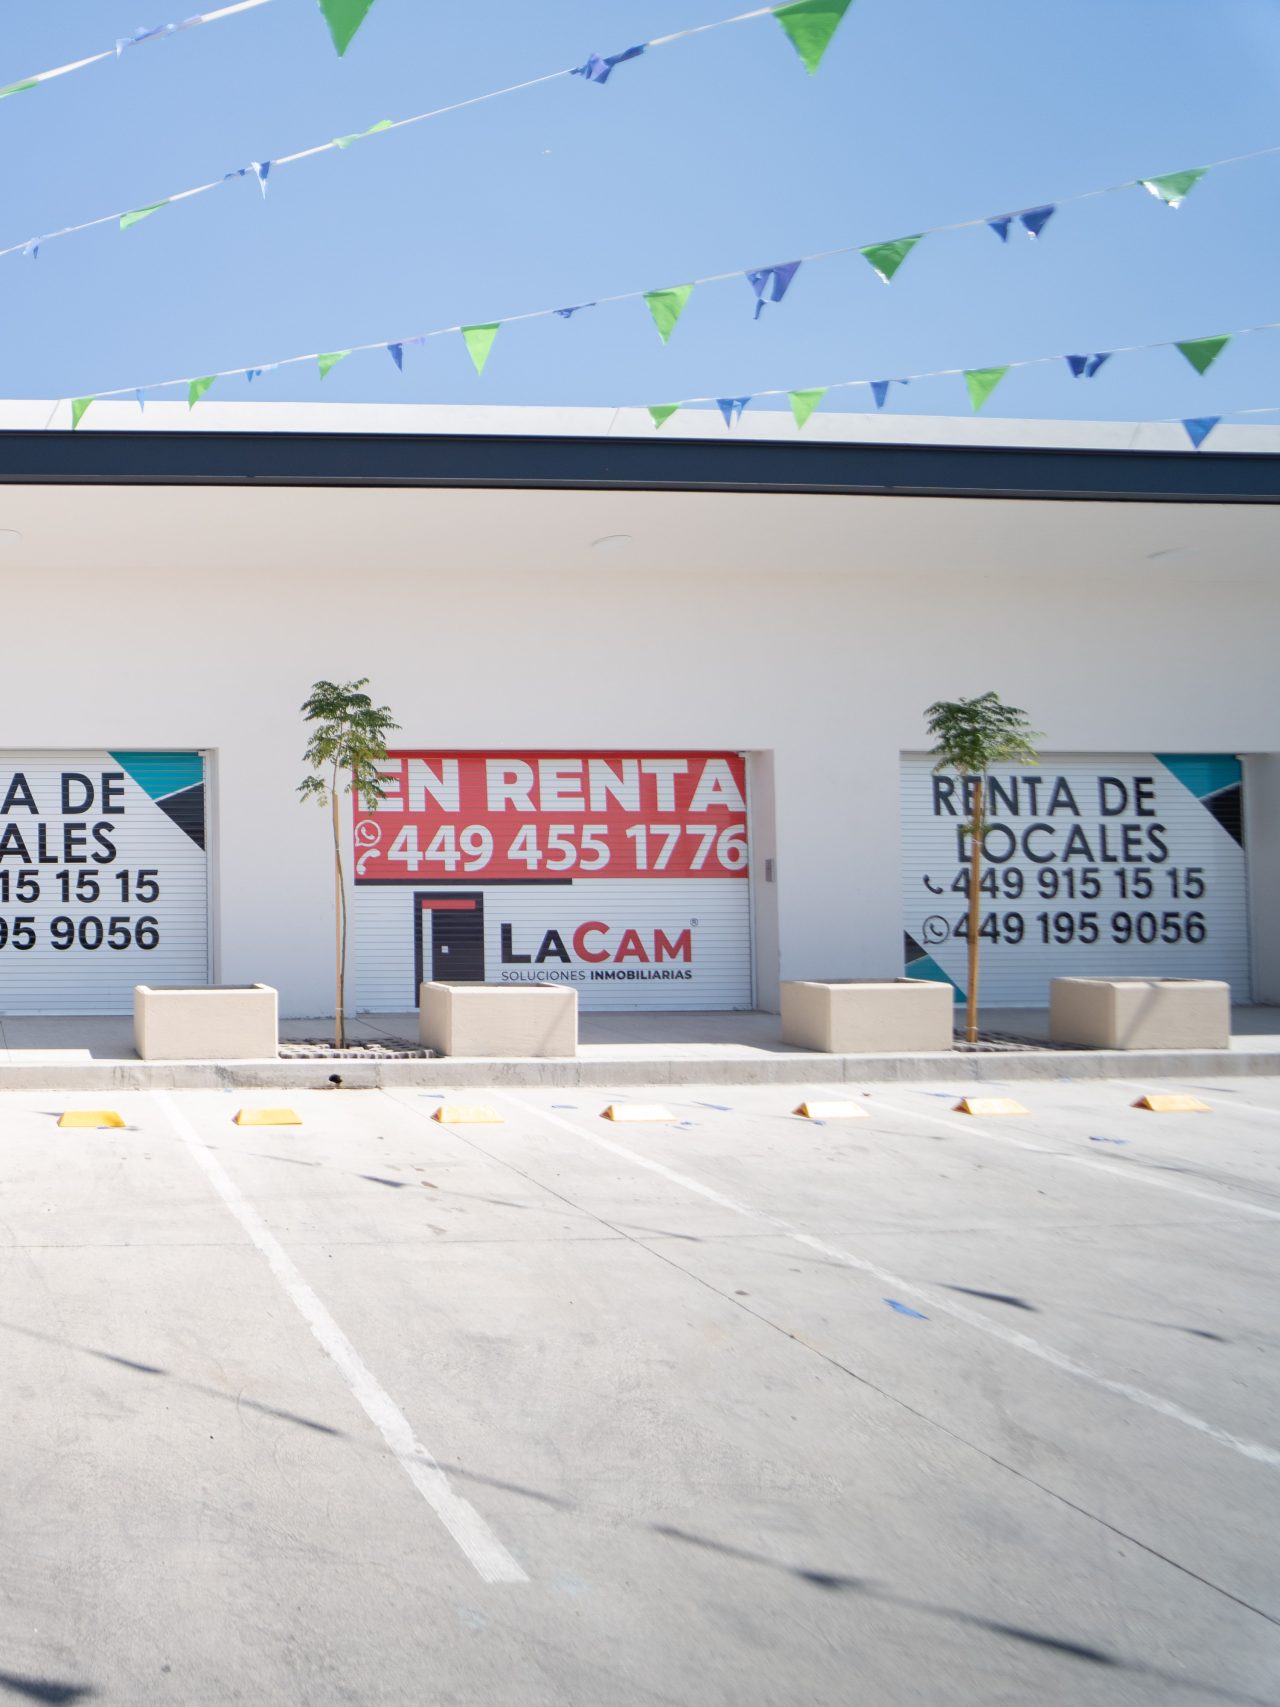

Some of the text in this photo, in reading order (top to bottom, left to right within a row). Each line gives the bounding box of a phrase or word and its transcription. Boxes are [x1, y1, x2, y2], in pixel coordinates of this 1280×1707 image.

[61, 772, 126, 815] DE
[358, 758, 747, 812] EN RENTA
[932, 775, 1156, 817] RENTA DE
[388, 823, 748, 872] 449 455 1776
[956, 822, 1169, 864] LOCALES
[55, 869, 100, 904] 15
[115, 869, 160, 904] 15
[950, 866, 1206, 900] 449 915 15 15
[50, 915, 160, 951] 9056
[952, 911, 1207, 945] 449 195 9056
[501, 969, 693, 982] SOLUCIONES INMOBILIARIAS
